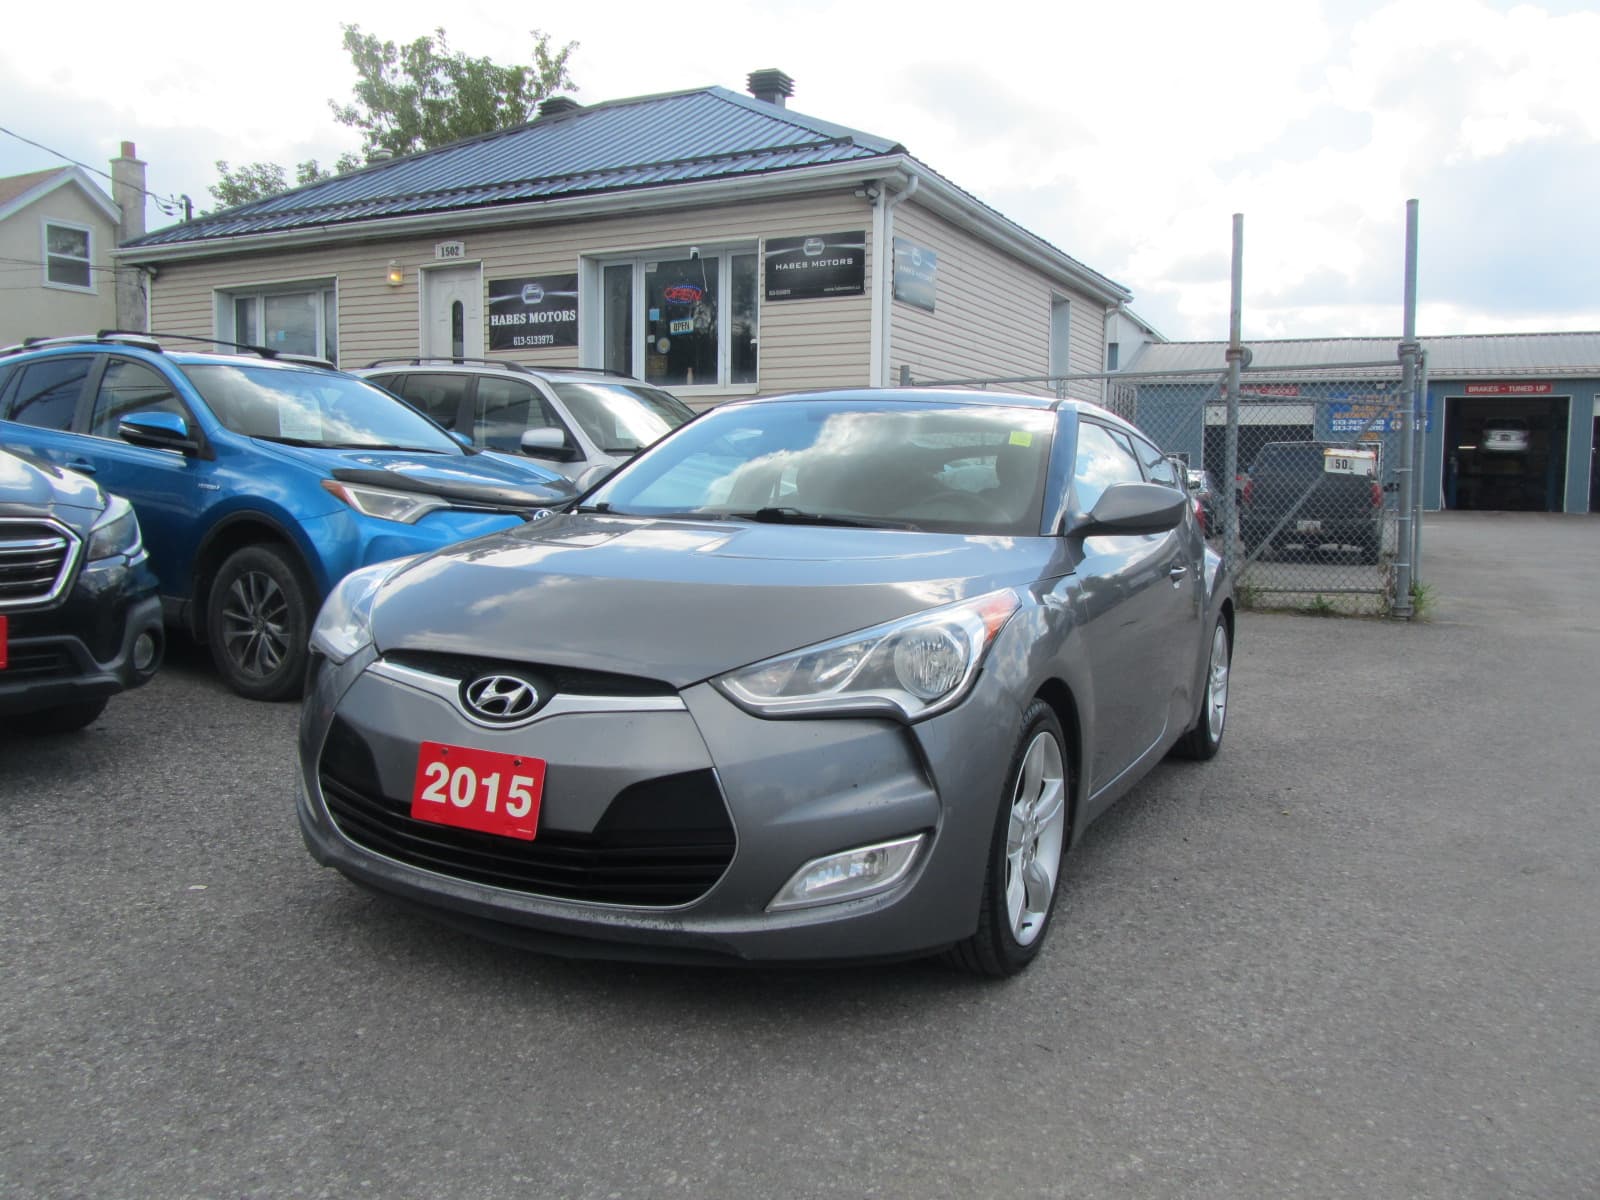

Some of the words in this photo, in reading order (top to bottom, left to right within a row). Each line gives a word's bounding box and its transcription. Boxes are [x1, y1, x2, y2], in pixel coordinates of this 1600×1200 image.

[441, 246, 460, 257] 1502
[776, 261, 808, 270] HABES
[812, 258, 853, 268] MOTORS
[491, 313, 526, 326] HABES
[529, 310, 576, 324] MOTORS
[673, 321, 690, 332] OPEN
[1468, 384, 1499, 393] BRAKES
[1509, 384, 1534, 392] TUNED
[1536, 384, 1547, 392] UP
[421, 761, 534, 818] 2015
